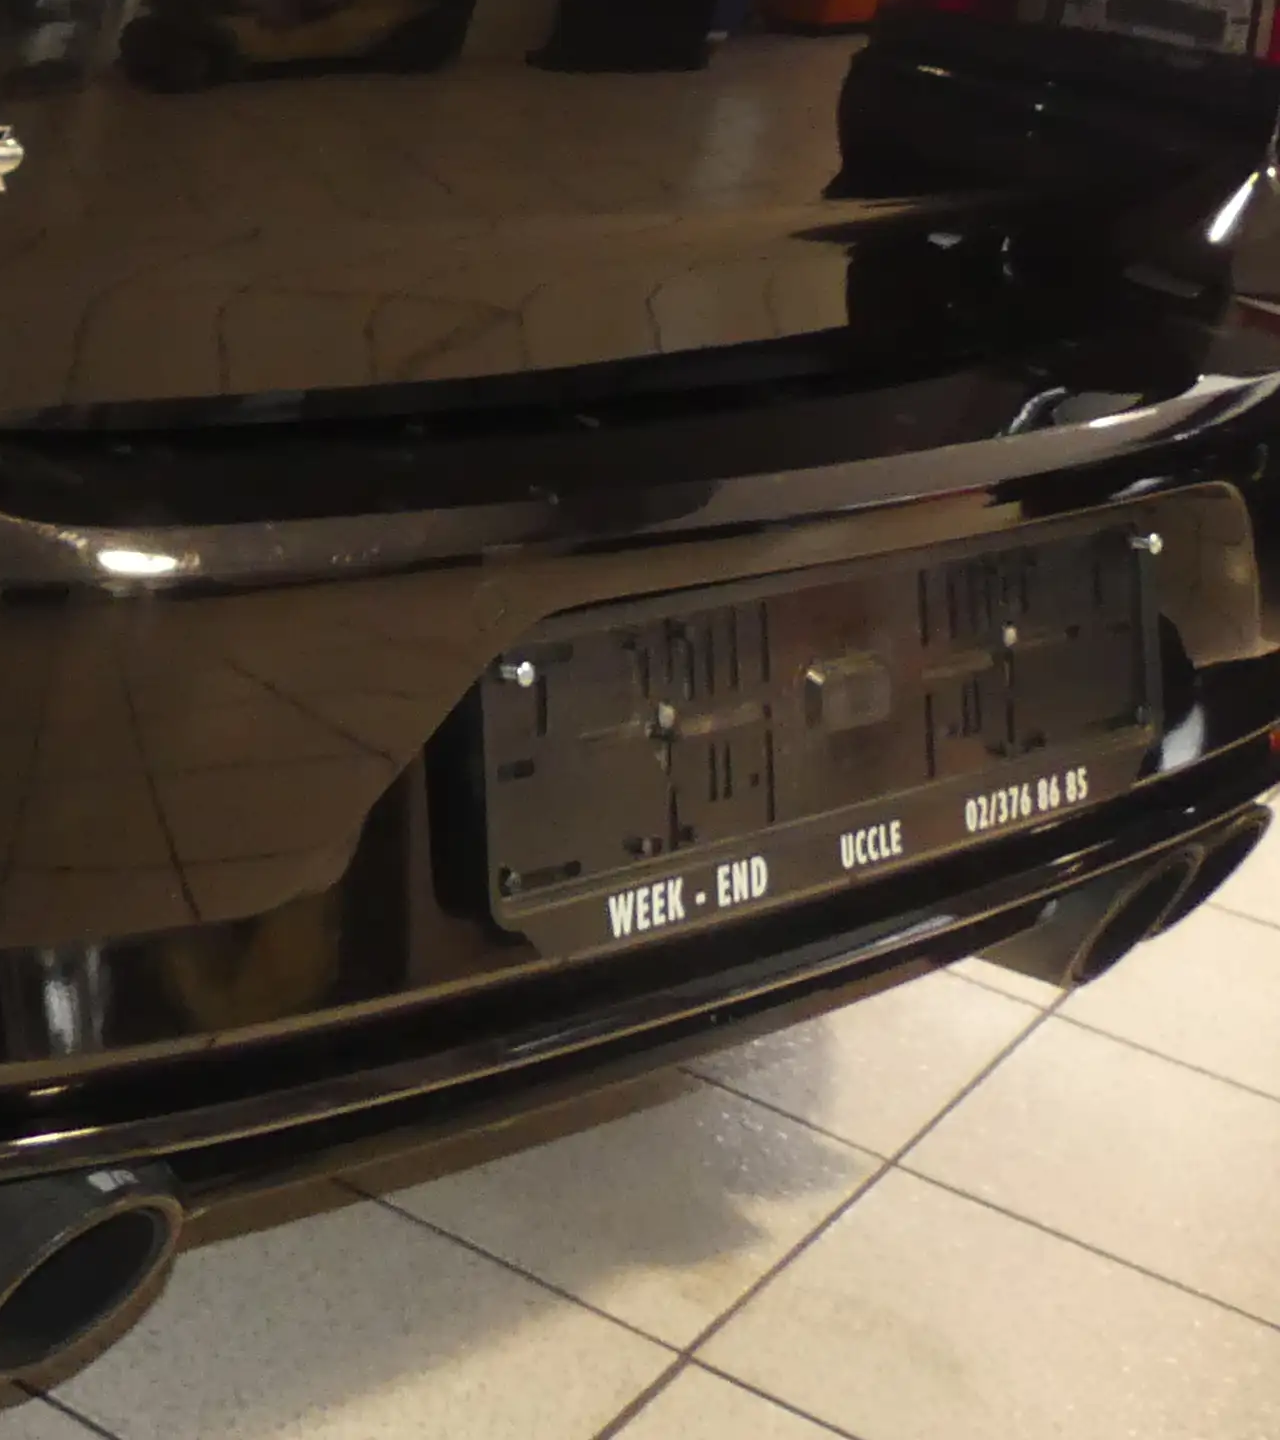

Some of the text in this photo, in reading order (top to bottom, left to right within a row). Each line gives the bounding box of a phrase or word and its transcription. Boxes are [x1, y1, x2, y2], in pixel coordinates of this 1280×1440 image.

[608, 876, 685, 939] WEEK
[716, 855, 769, 908] END
[841, 819, 903, 869] UCCLE
[964, 782, 1032, 832] 02/376
[1037, 774, 1061, 812] 86
